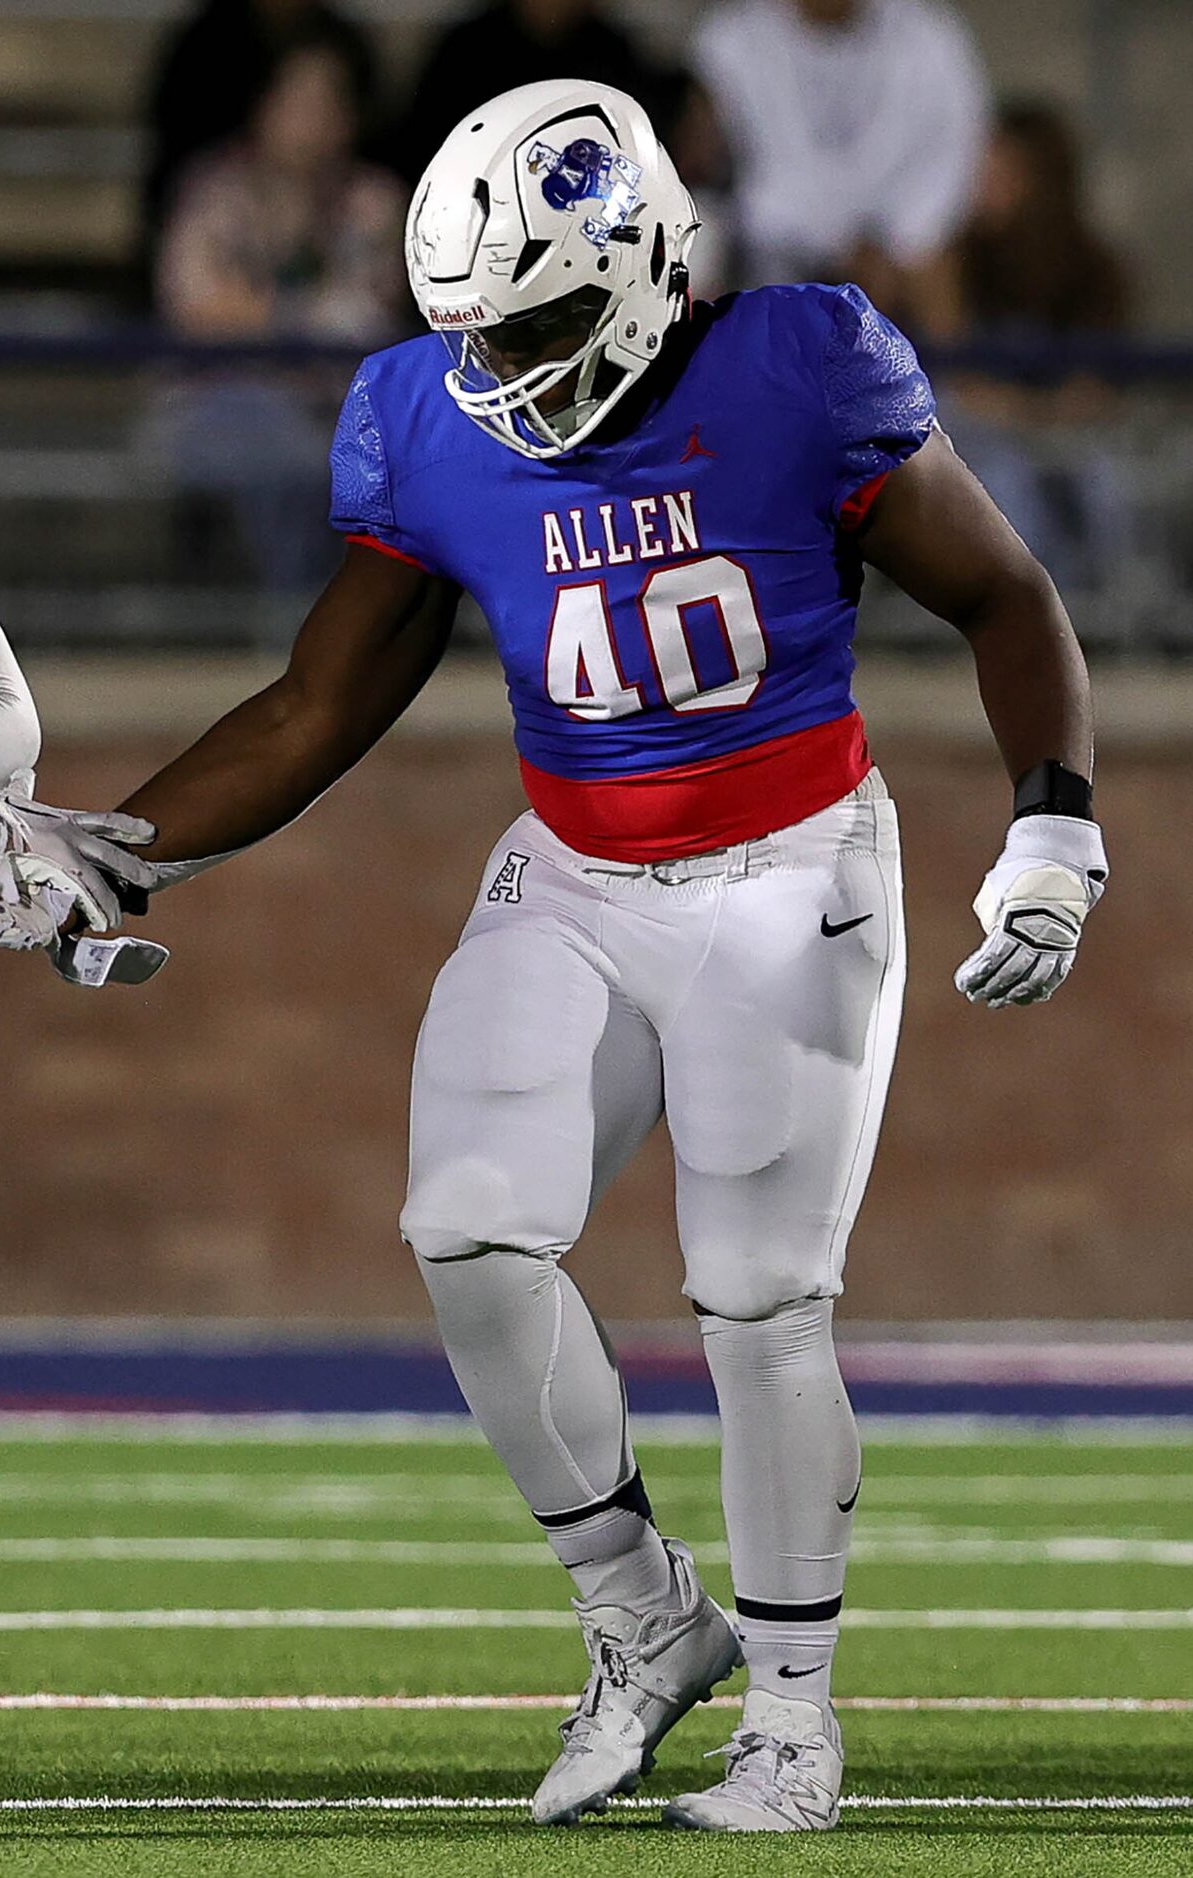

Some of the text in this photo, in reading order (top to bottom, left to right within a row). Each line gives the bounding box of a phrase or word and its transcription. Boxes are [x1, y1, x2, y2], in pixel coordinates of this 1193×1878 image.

[429, 305, 486, 324] Riddell
[542, 489, 701, 575] ALLEN
[544, 554, 769, 722] 40
[488, 851, 530, 903] A
